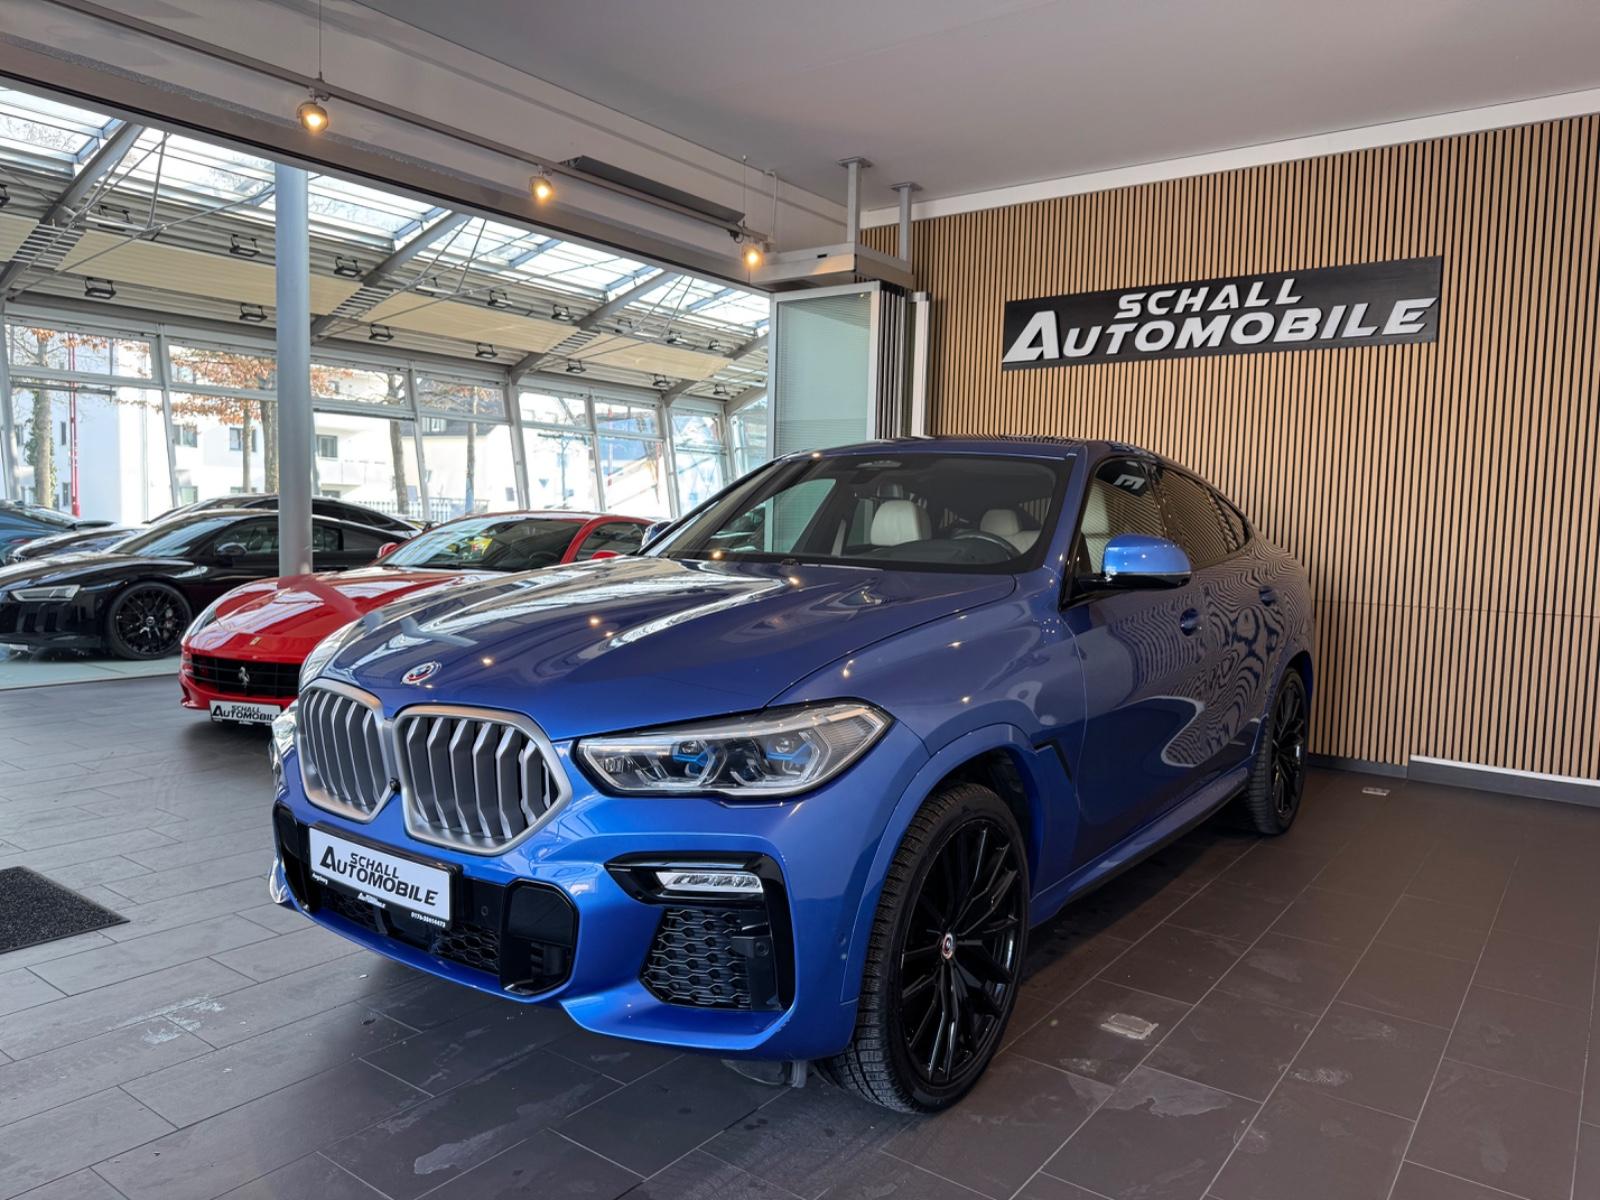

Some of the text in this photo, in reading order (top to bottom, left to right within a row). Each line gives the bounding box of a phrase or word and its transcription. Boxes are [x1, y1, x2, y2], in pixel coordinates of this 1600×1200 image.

[1114, 278, 1303, 320] SCHALL
[1002, 297, 1437, 363] AUTOMOBILE
[231, 705, 261, 713] SCHALL
[319, 845, 439, 906] AUTOMOBILE
[350, 853, 399, 879] SCHALL
